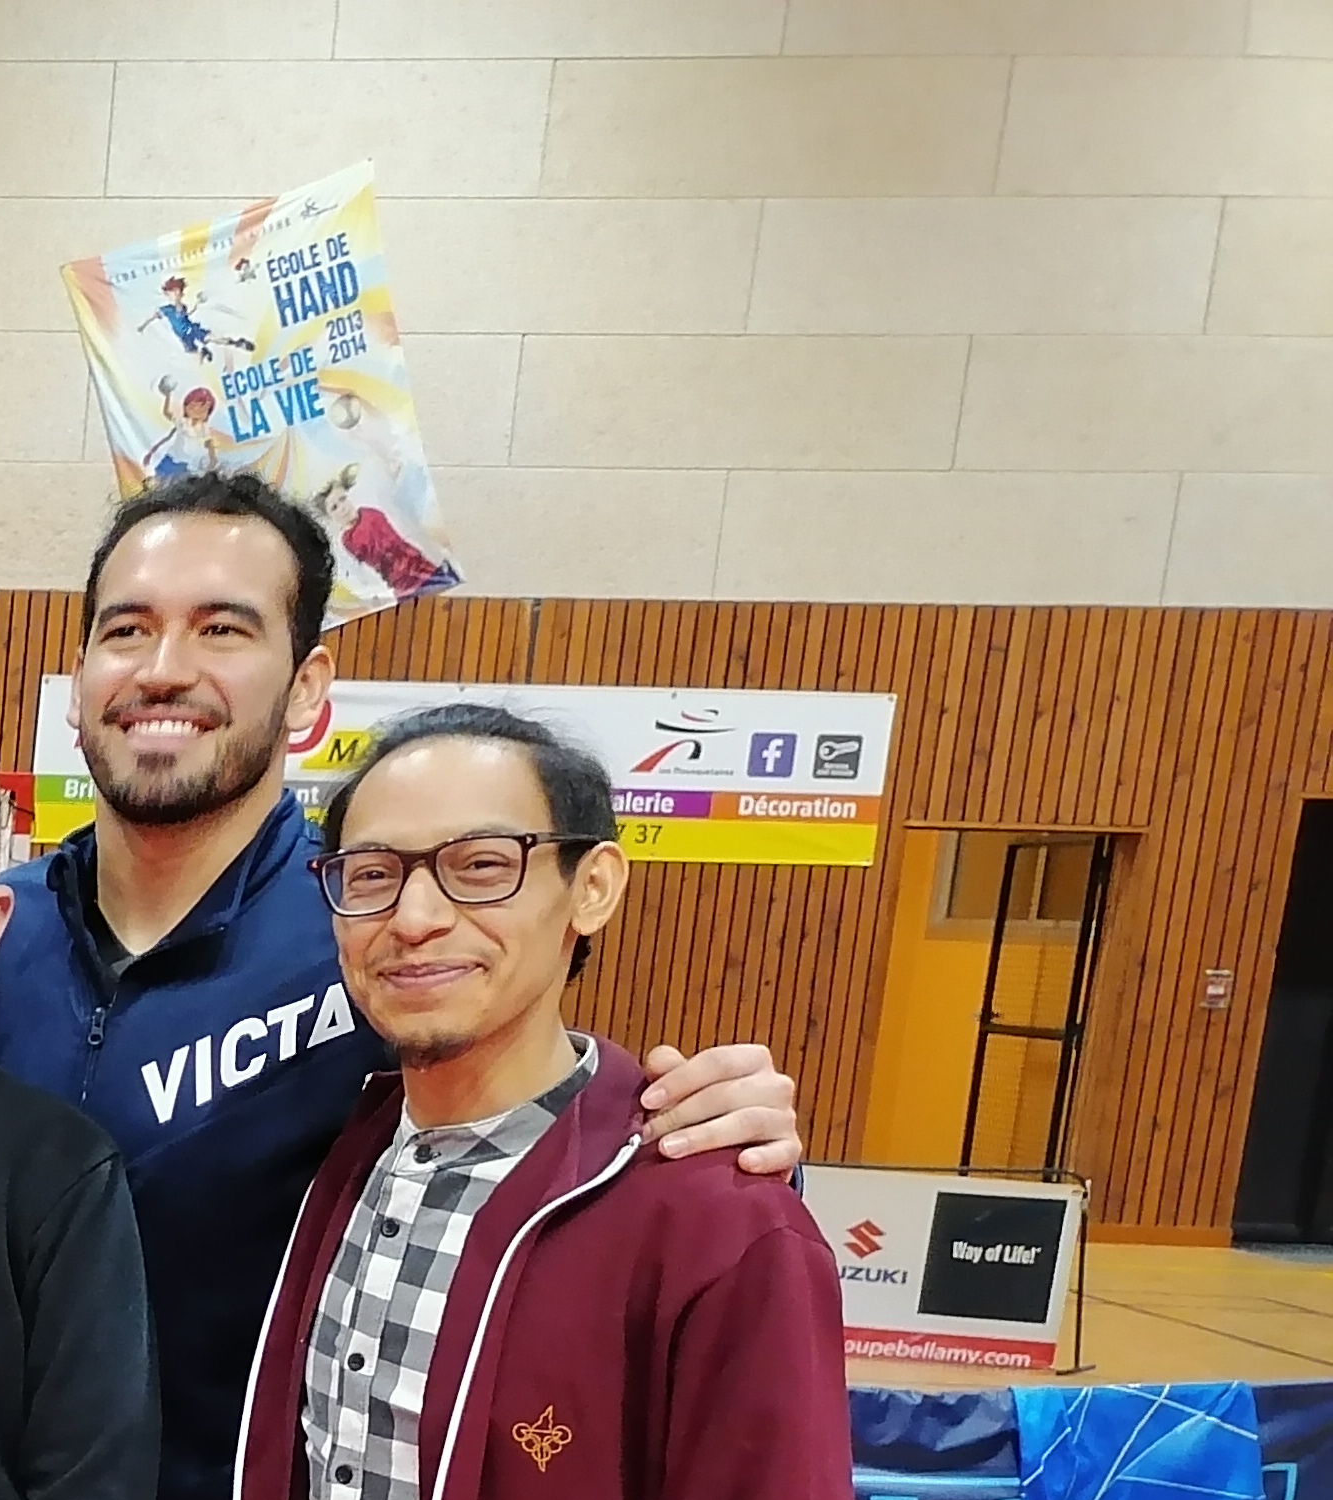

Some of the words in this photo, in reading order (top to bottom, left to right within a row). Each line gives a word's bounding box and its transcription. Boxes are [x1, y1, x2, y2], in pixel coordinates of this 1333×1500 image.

[266, 243, 321, 283] ÉCOLE
[326, 232, 350, 262] DE
[272, 260, 360, 328] HAND
[325, 309, 364, 341] 2013
[329, 334, 369, 365] 2014
[221, 357, 283, 401] ÉCOLE
[291, 347, 317, 377] DE
[227, 399, 271, 443] LA
[274, 378, 326, 428] VIE
[613, 791, 674, 813] alerie
[738, 795, 857, 819] Décoration
[634, 824, 663, 845] 37
[140, 982, 356, 1124] VICTA
[952, 1241, 983, 1264] Way
[985, 1244, 1004, 1263] of
[844, 1339, 1032, 1368] oupebellamy.com
